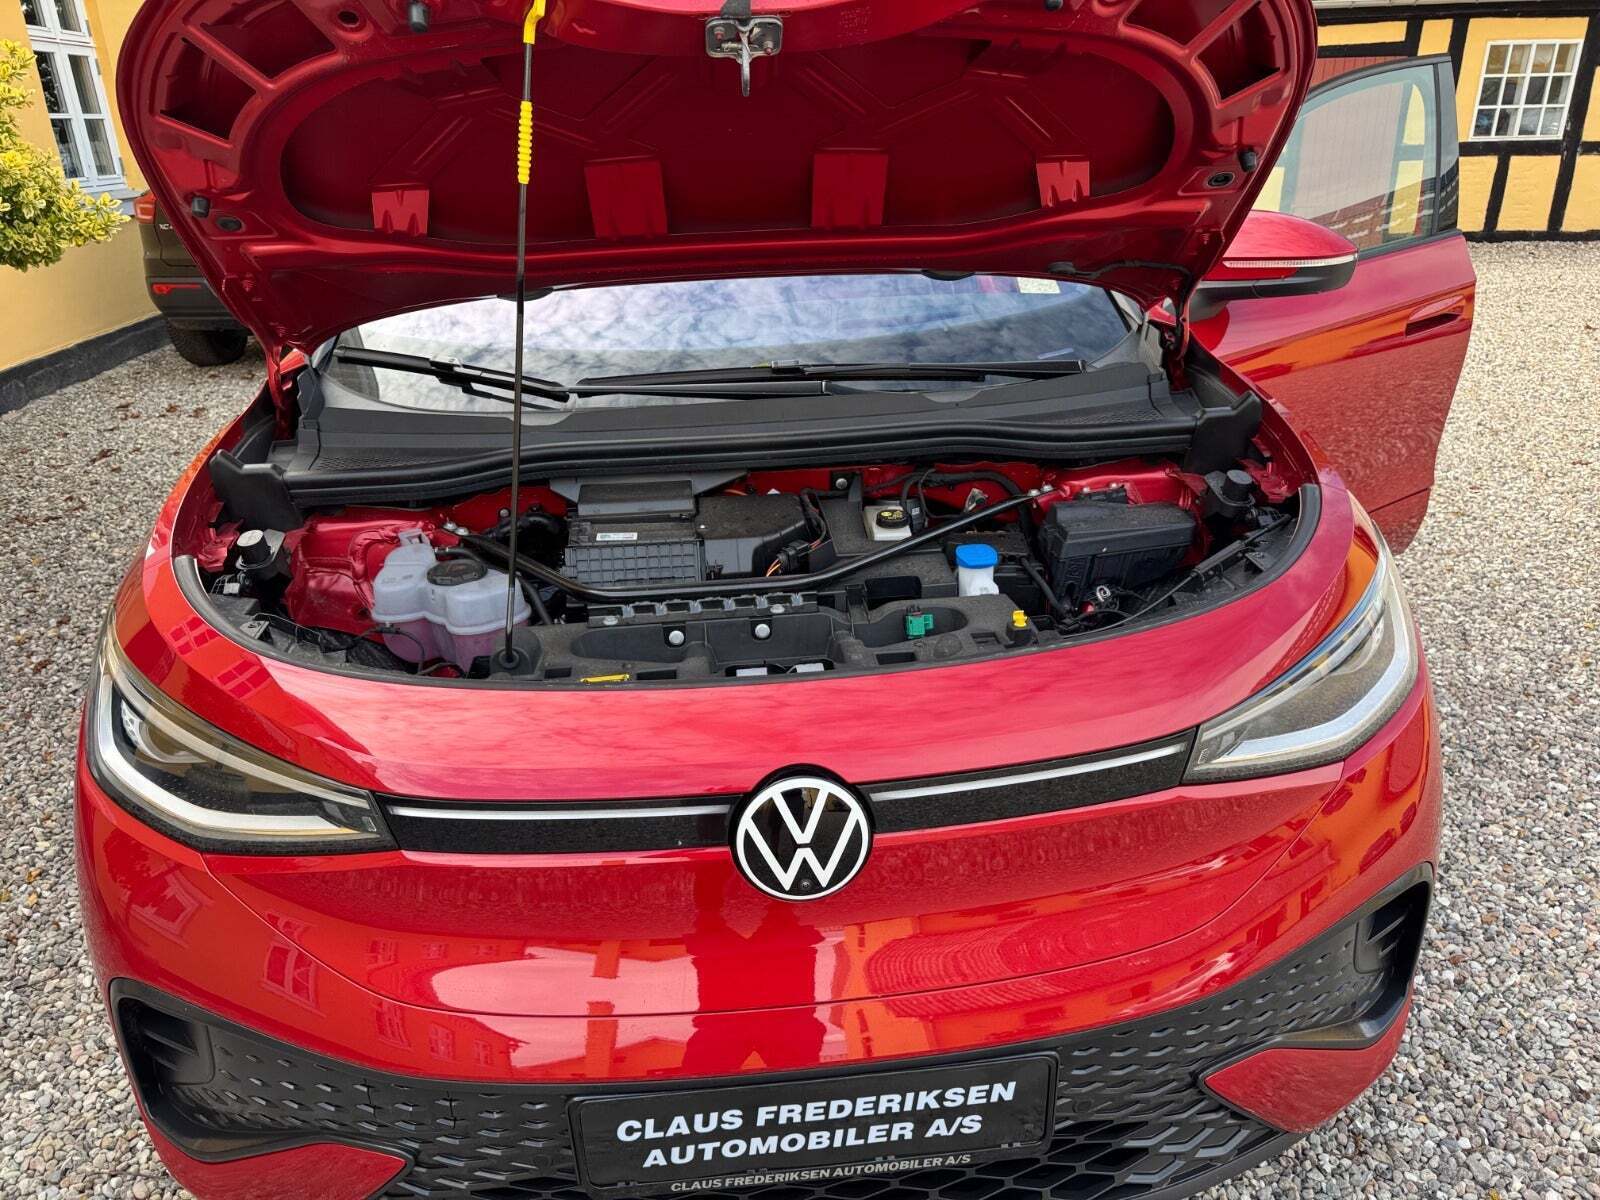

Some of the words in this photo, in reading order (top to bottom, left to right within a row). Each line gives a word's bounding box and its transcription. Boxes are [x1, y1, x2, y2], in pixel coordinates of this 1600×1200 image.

[616, 1109, 744, 1142] CLAUS
[756, 1081, 1017, 1127] FREDERIKSEN
[642, 1121, 915, 1168] AUTOMOBILER
[924, 1114, 983, 1138] A/S
[670, 1178, 722, 1192] CLAUS
[724, 1168, 831, 1187] FREDERIKSEN
[832, 1157, 943, 1178] AUTOMOBILER
[944, 1154, 972, 1166] A/S
